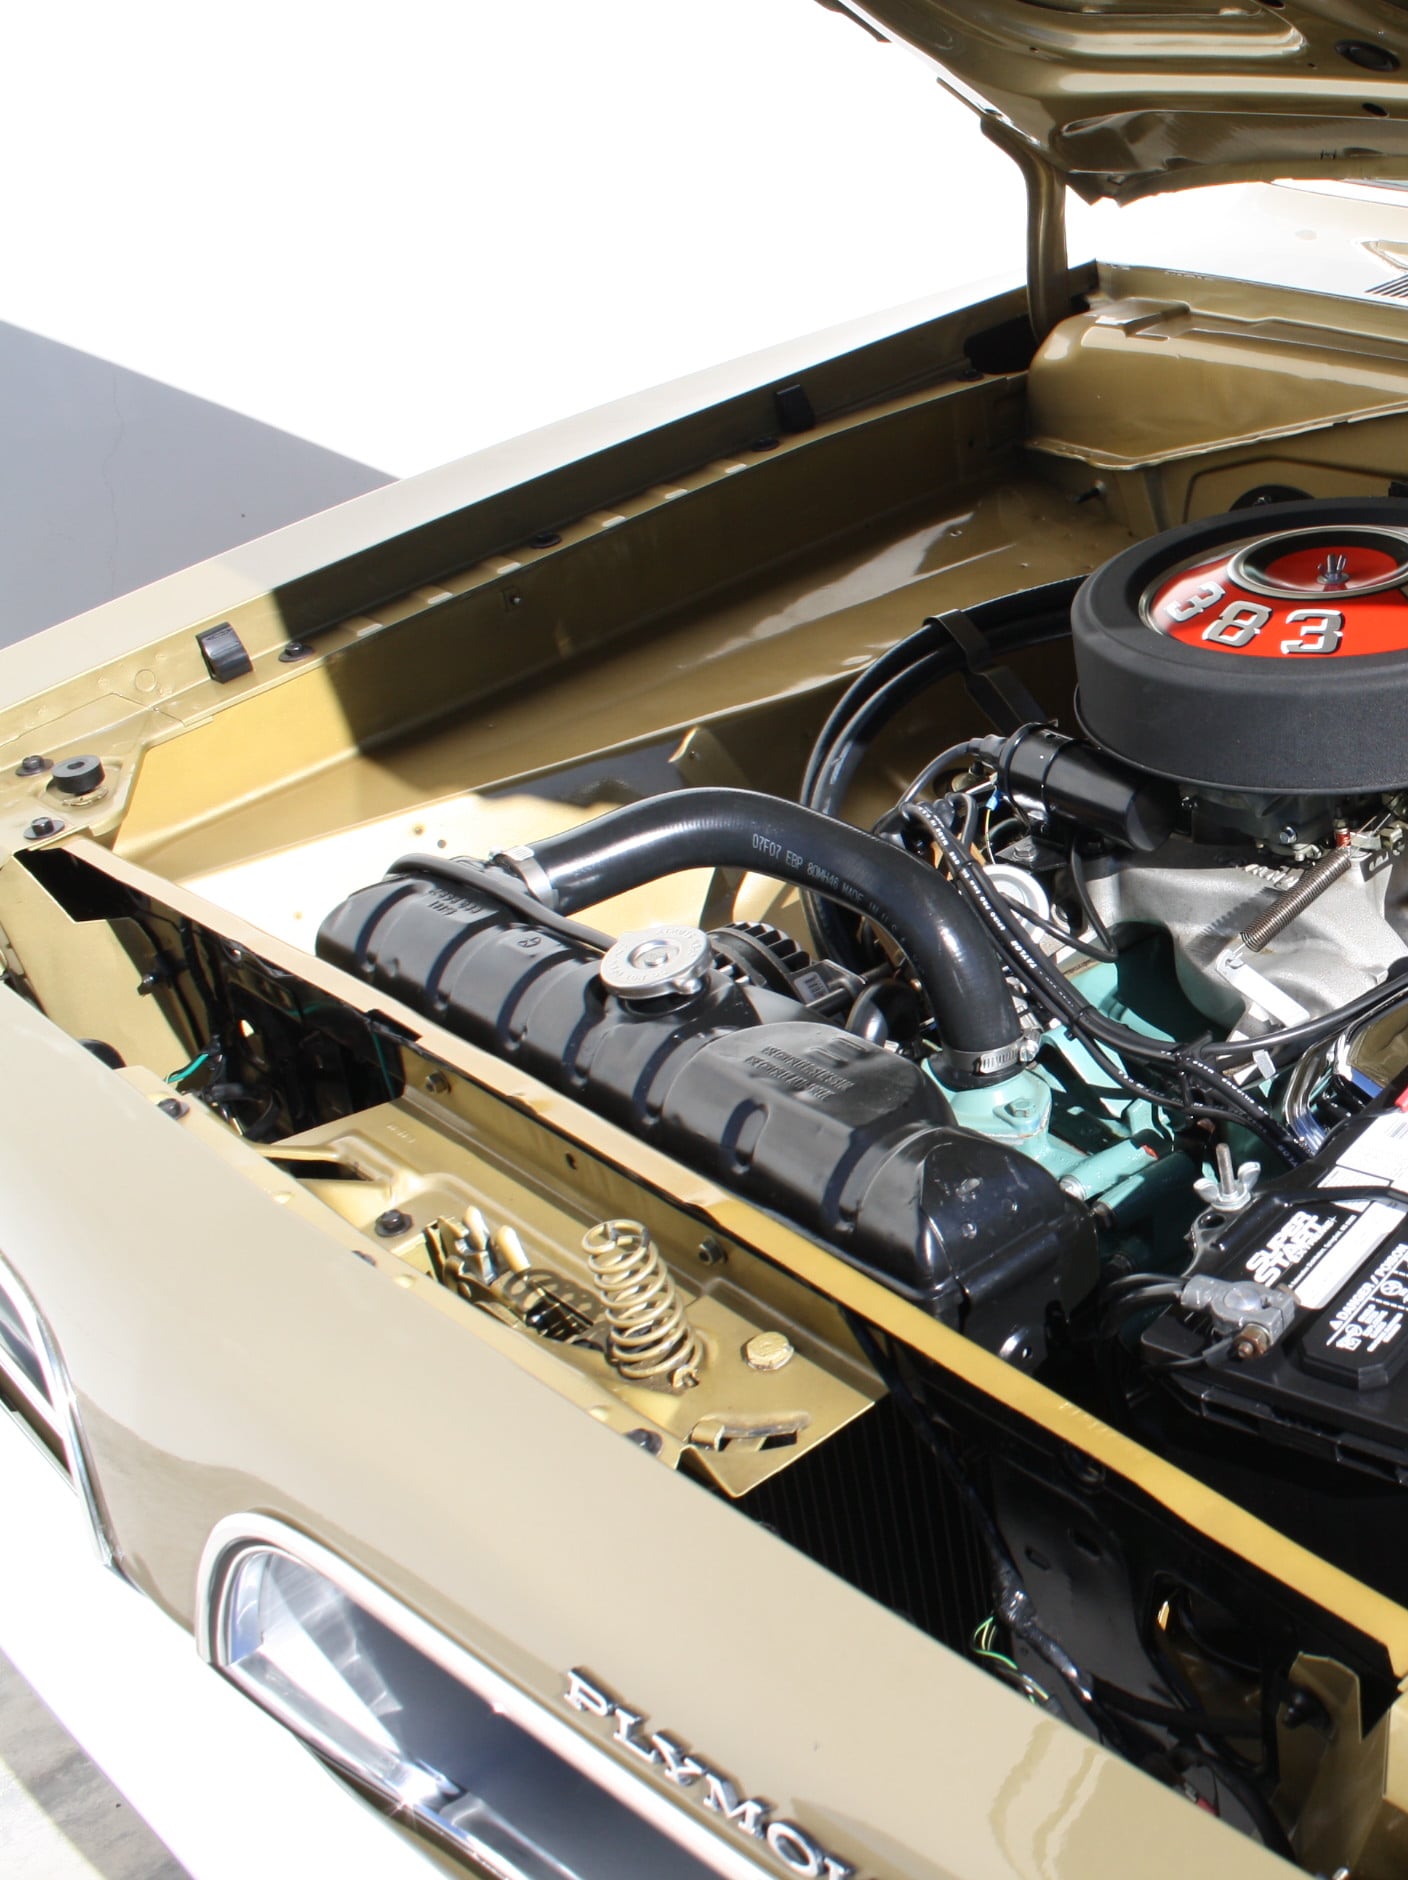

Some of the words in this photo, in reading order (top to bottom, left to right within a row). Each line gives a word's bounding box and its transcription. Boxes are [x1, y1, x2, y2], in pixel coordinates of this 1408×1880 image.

[1166, 580, 1344, 655] 383
[752, 834, 782, 859] 07F07
[1010, 939, 1037, 968] TAYLOR
[1246, 1209, 1314, 1271] SUPER
[1254, 1214, 1326, 1287] START
[1336, 1281, 1373, 1321] DANGER
